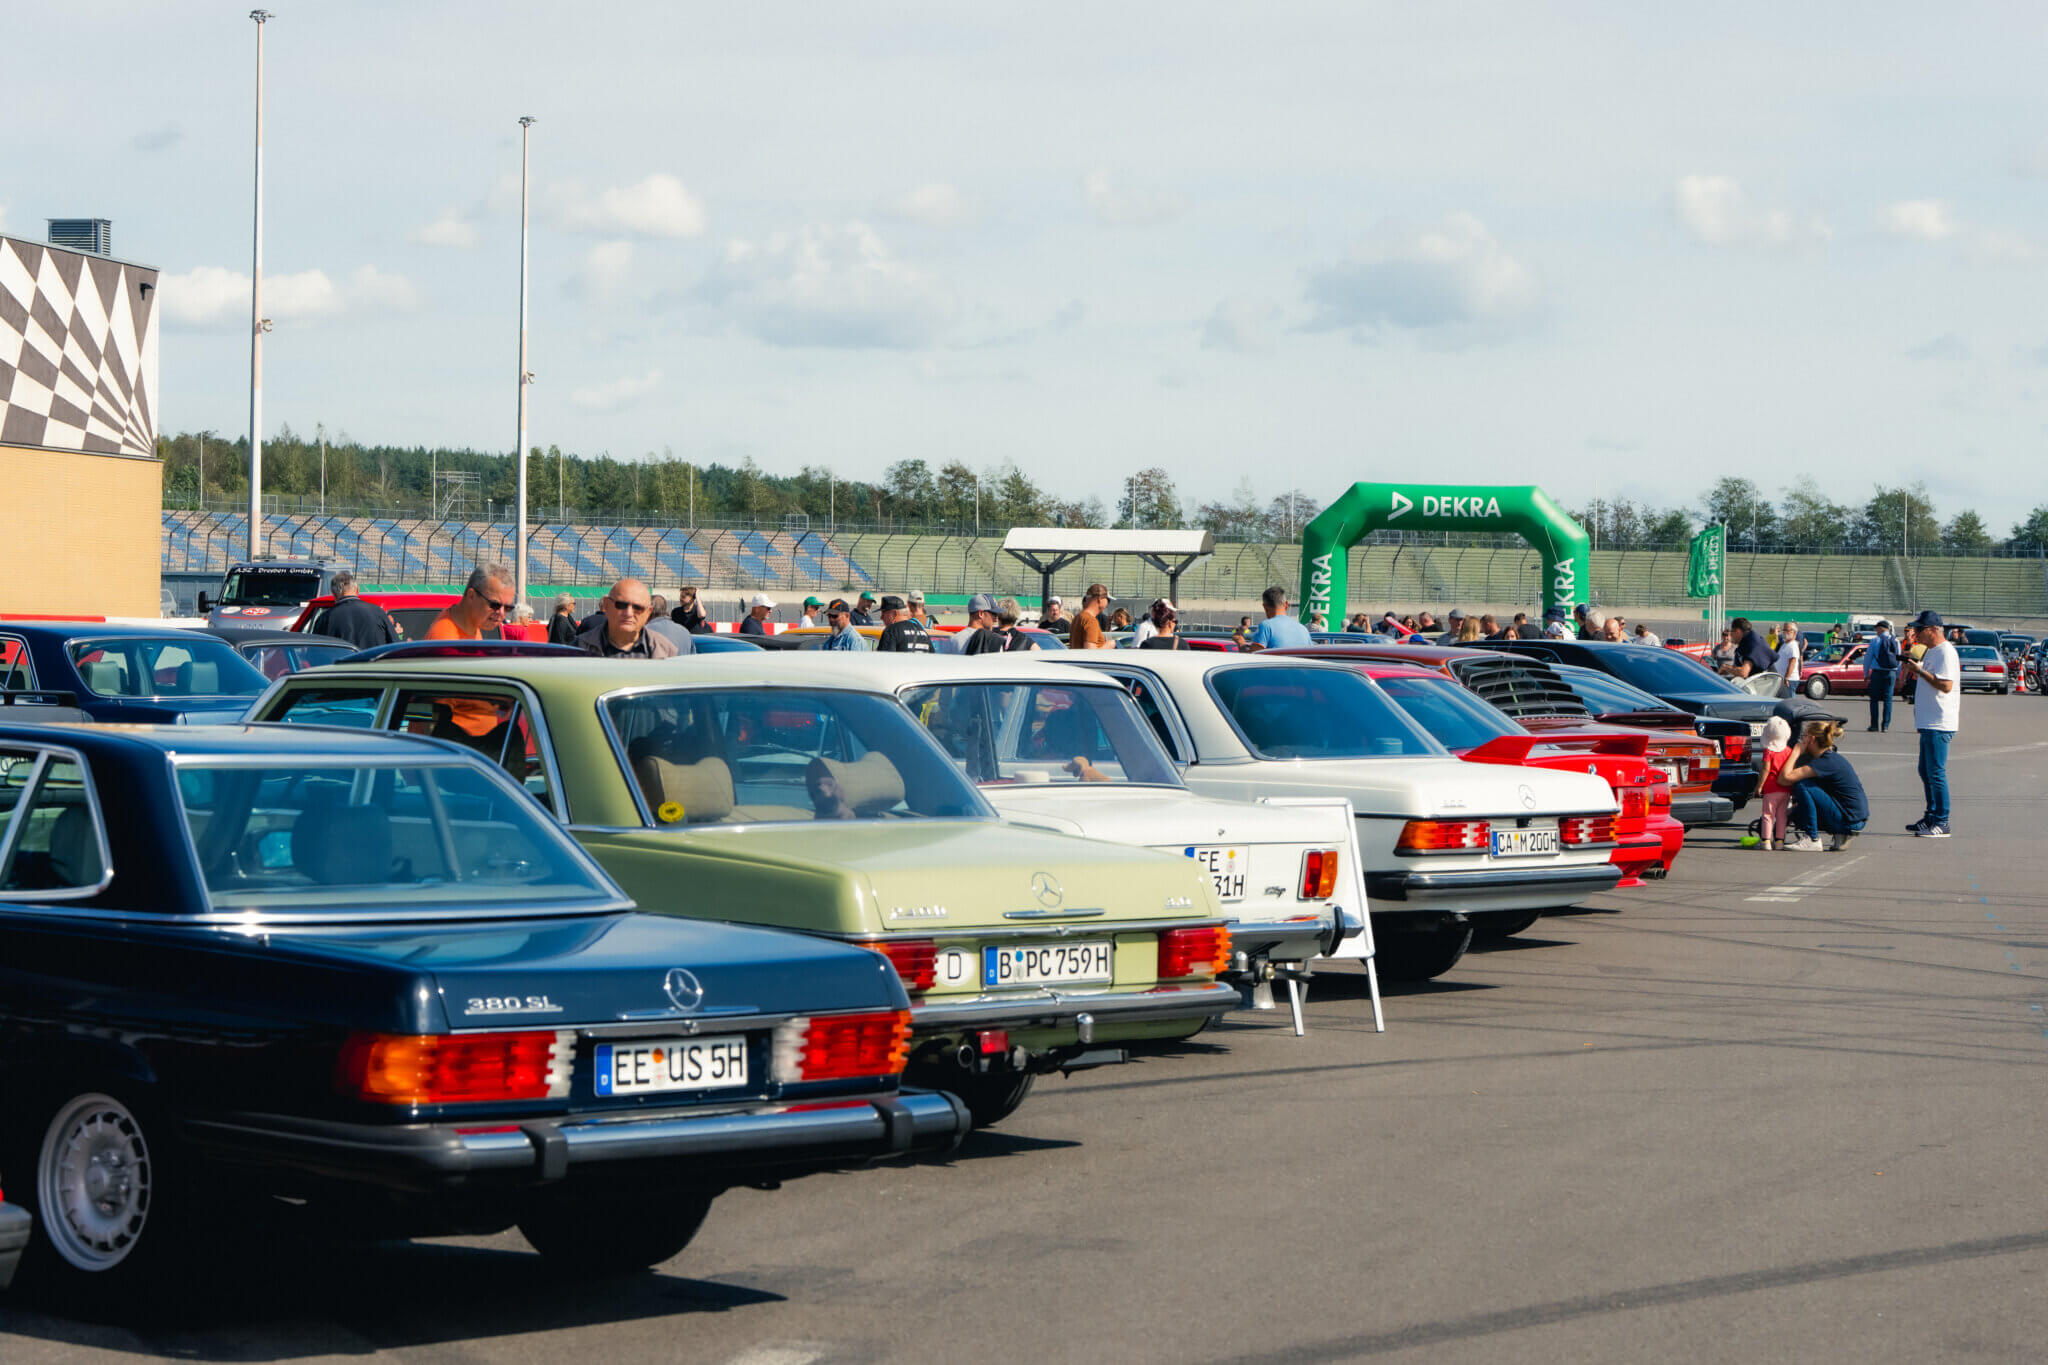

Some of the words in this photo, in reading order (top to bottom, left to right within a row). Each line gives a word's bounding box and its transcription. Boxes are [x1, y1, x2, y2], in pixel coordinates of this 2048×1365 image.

[1423, 495, 1501, 517] DEKRA
[1498, 833, 1513, 852] CA
[1520, 832, 1527, 852] M
[1530, 831, 1558, 851] 200H
[948, 952, 962, 979] D
[1000, 952, 1012, 978] B
[468, 997, 521, 1010] 380
[526, 995, 558, 1009] SL
[615, 1050, 650, 1086] EE
[669, 1045, 703, 1082] US
[711, 1043, 743, 1079] 5H
